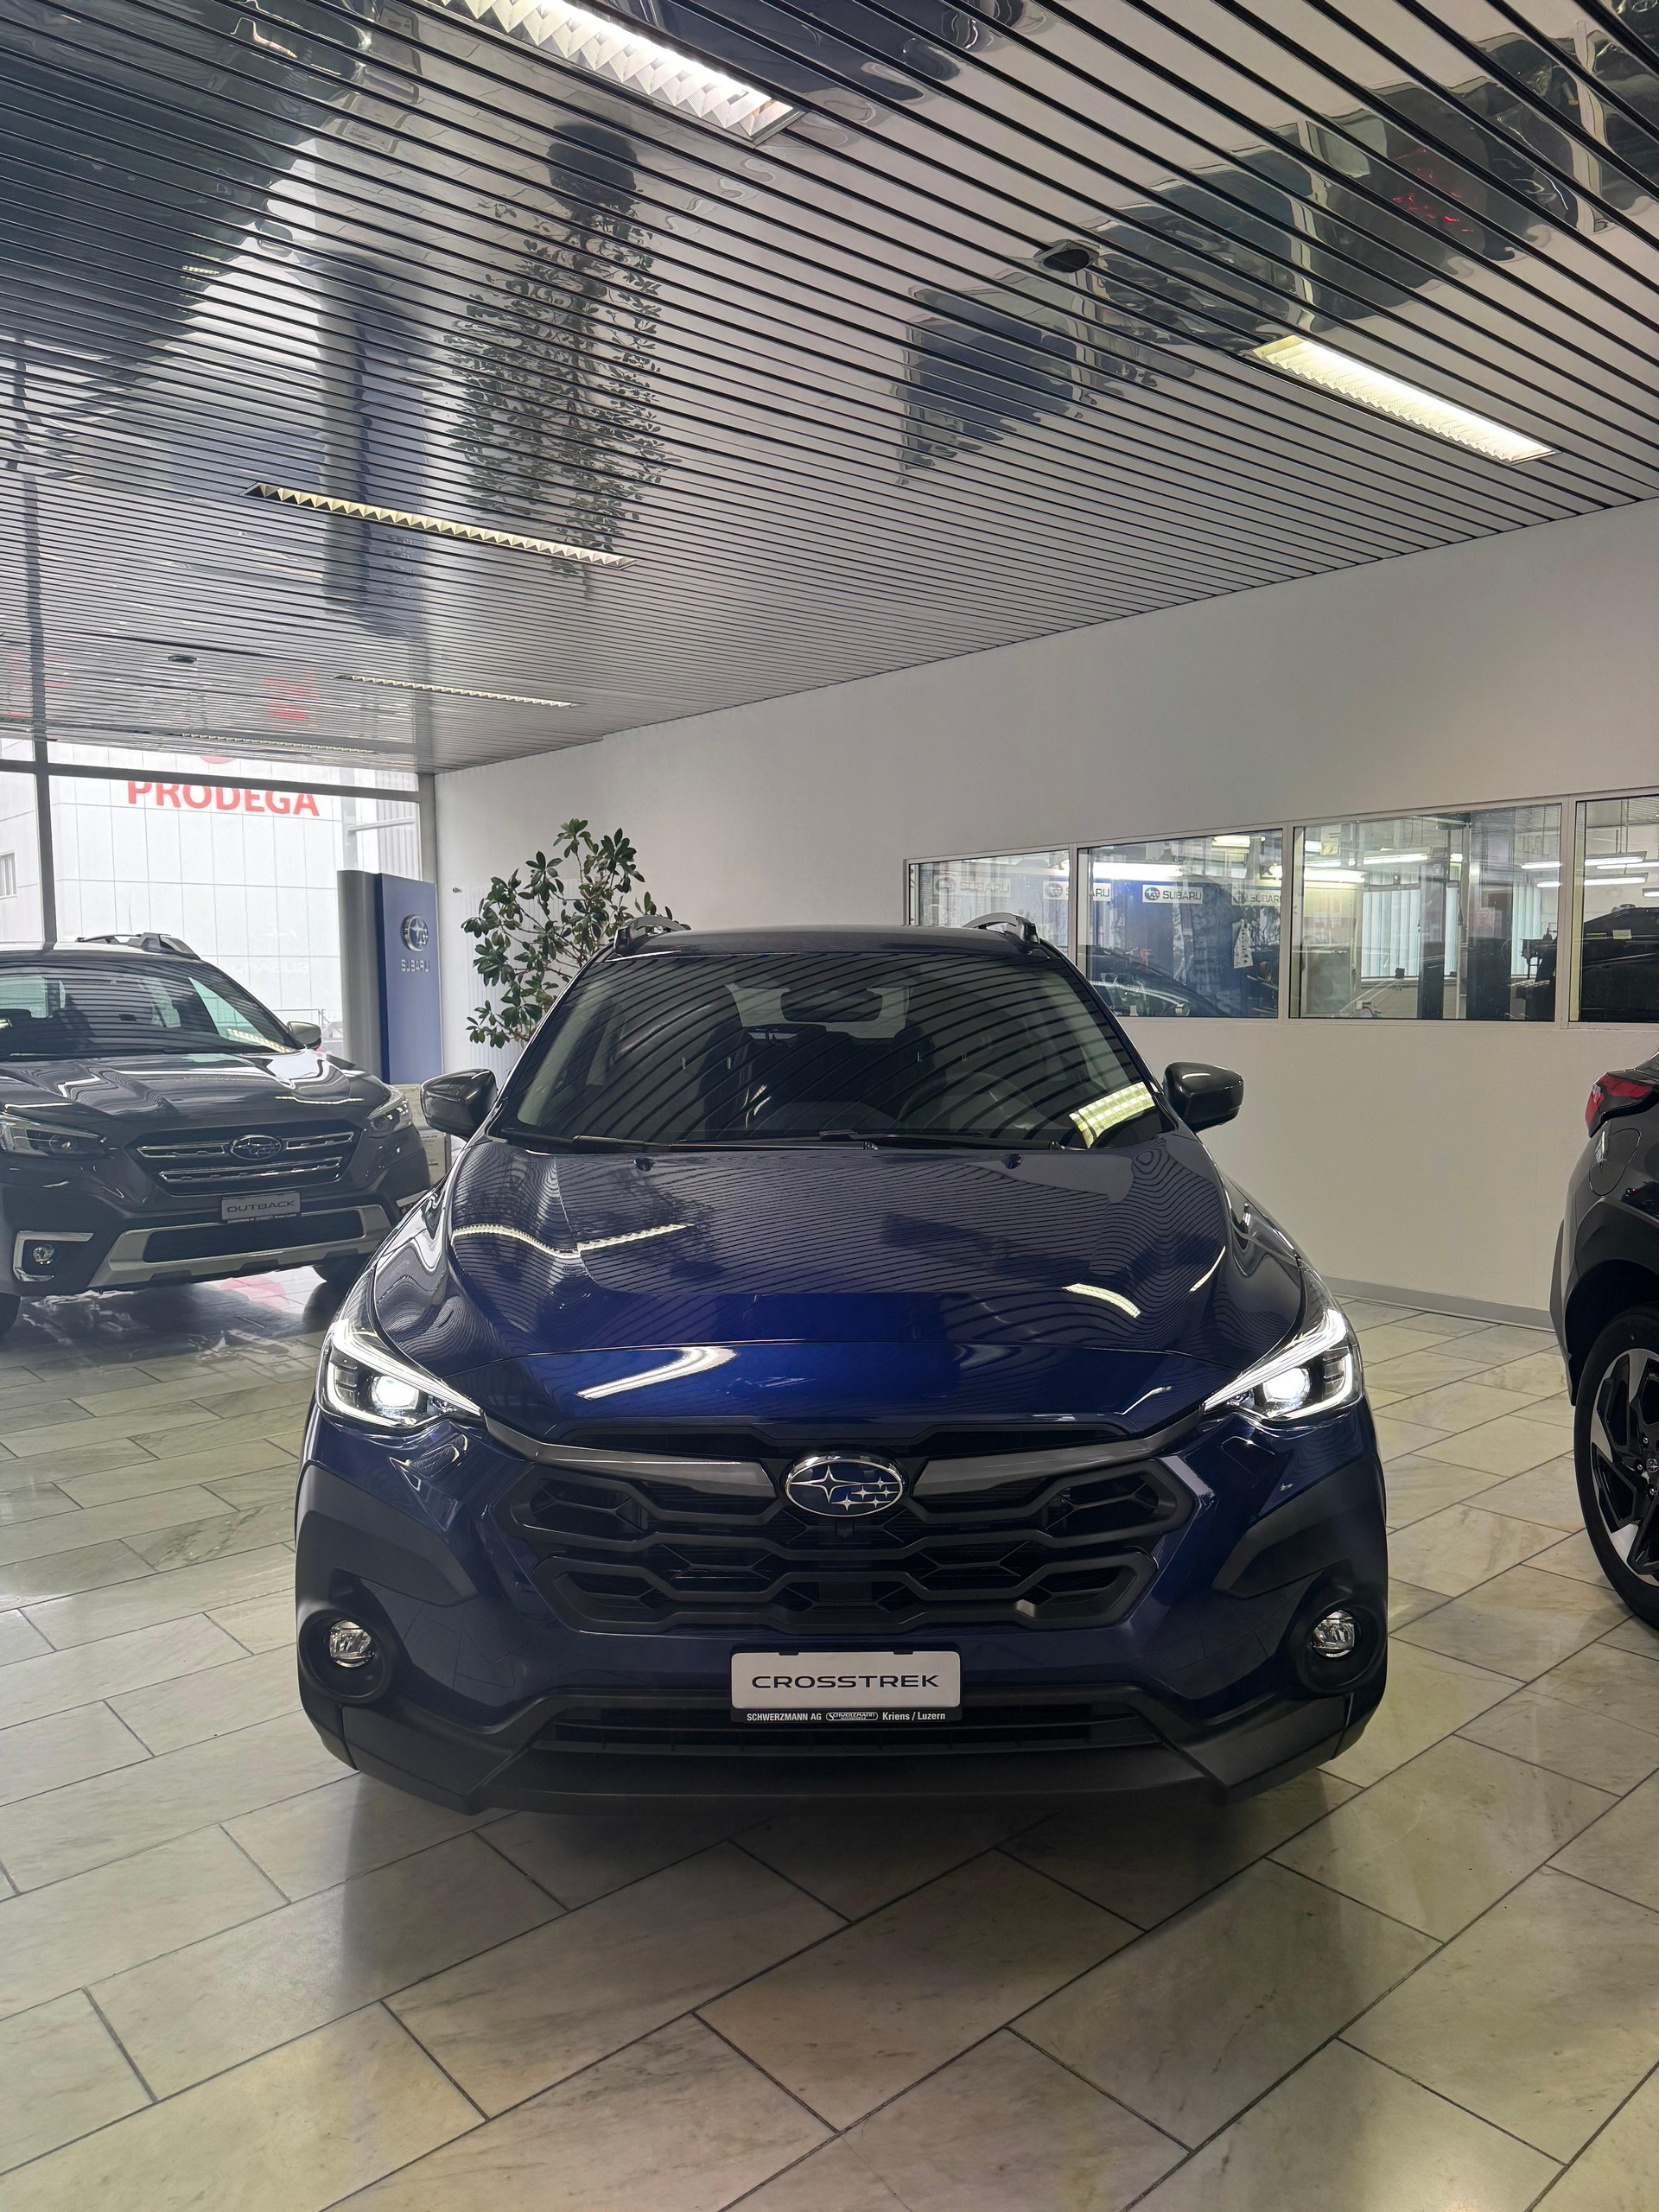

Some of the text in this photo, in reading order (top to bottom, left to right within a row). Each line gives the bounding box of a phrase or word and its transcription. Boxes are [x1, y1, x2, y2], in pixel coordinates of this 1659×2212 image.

[128, 780, 320, 816] PRODEGA
[960, 882, 1009, 893] SUBARU
[1163, 890, 1202, 900] SUBARU
[401, 959, 430, 973] SUBARU
[227, 1200, 295, 1212] OUTBACK
[752, 1675, 939, 1688] CROSSTREK
[747, 1713, 822, 1721] SCHWERZMANN AG
[882, 1712, 910, 1720] Kriens
[918, 1711, 945, 1720] Luzern
